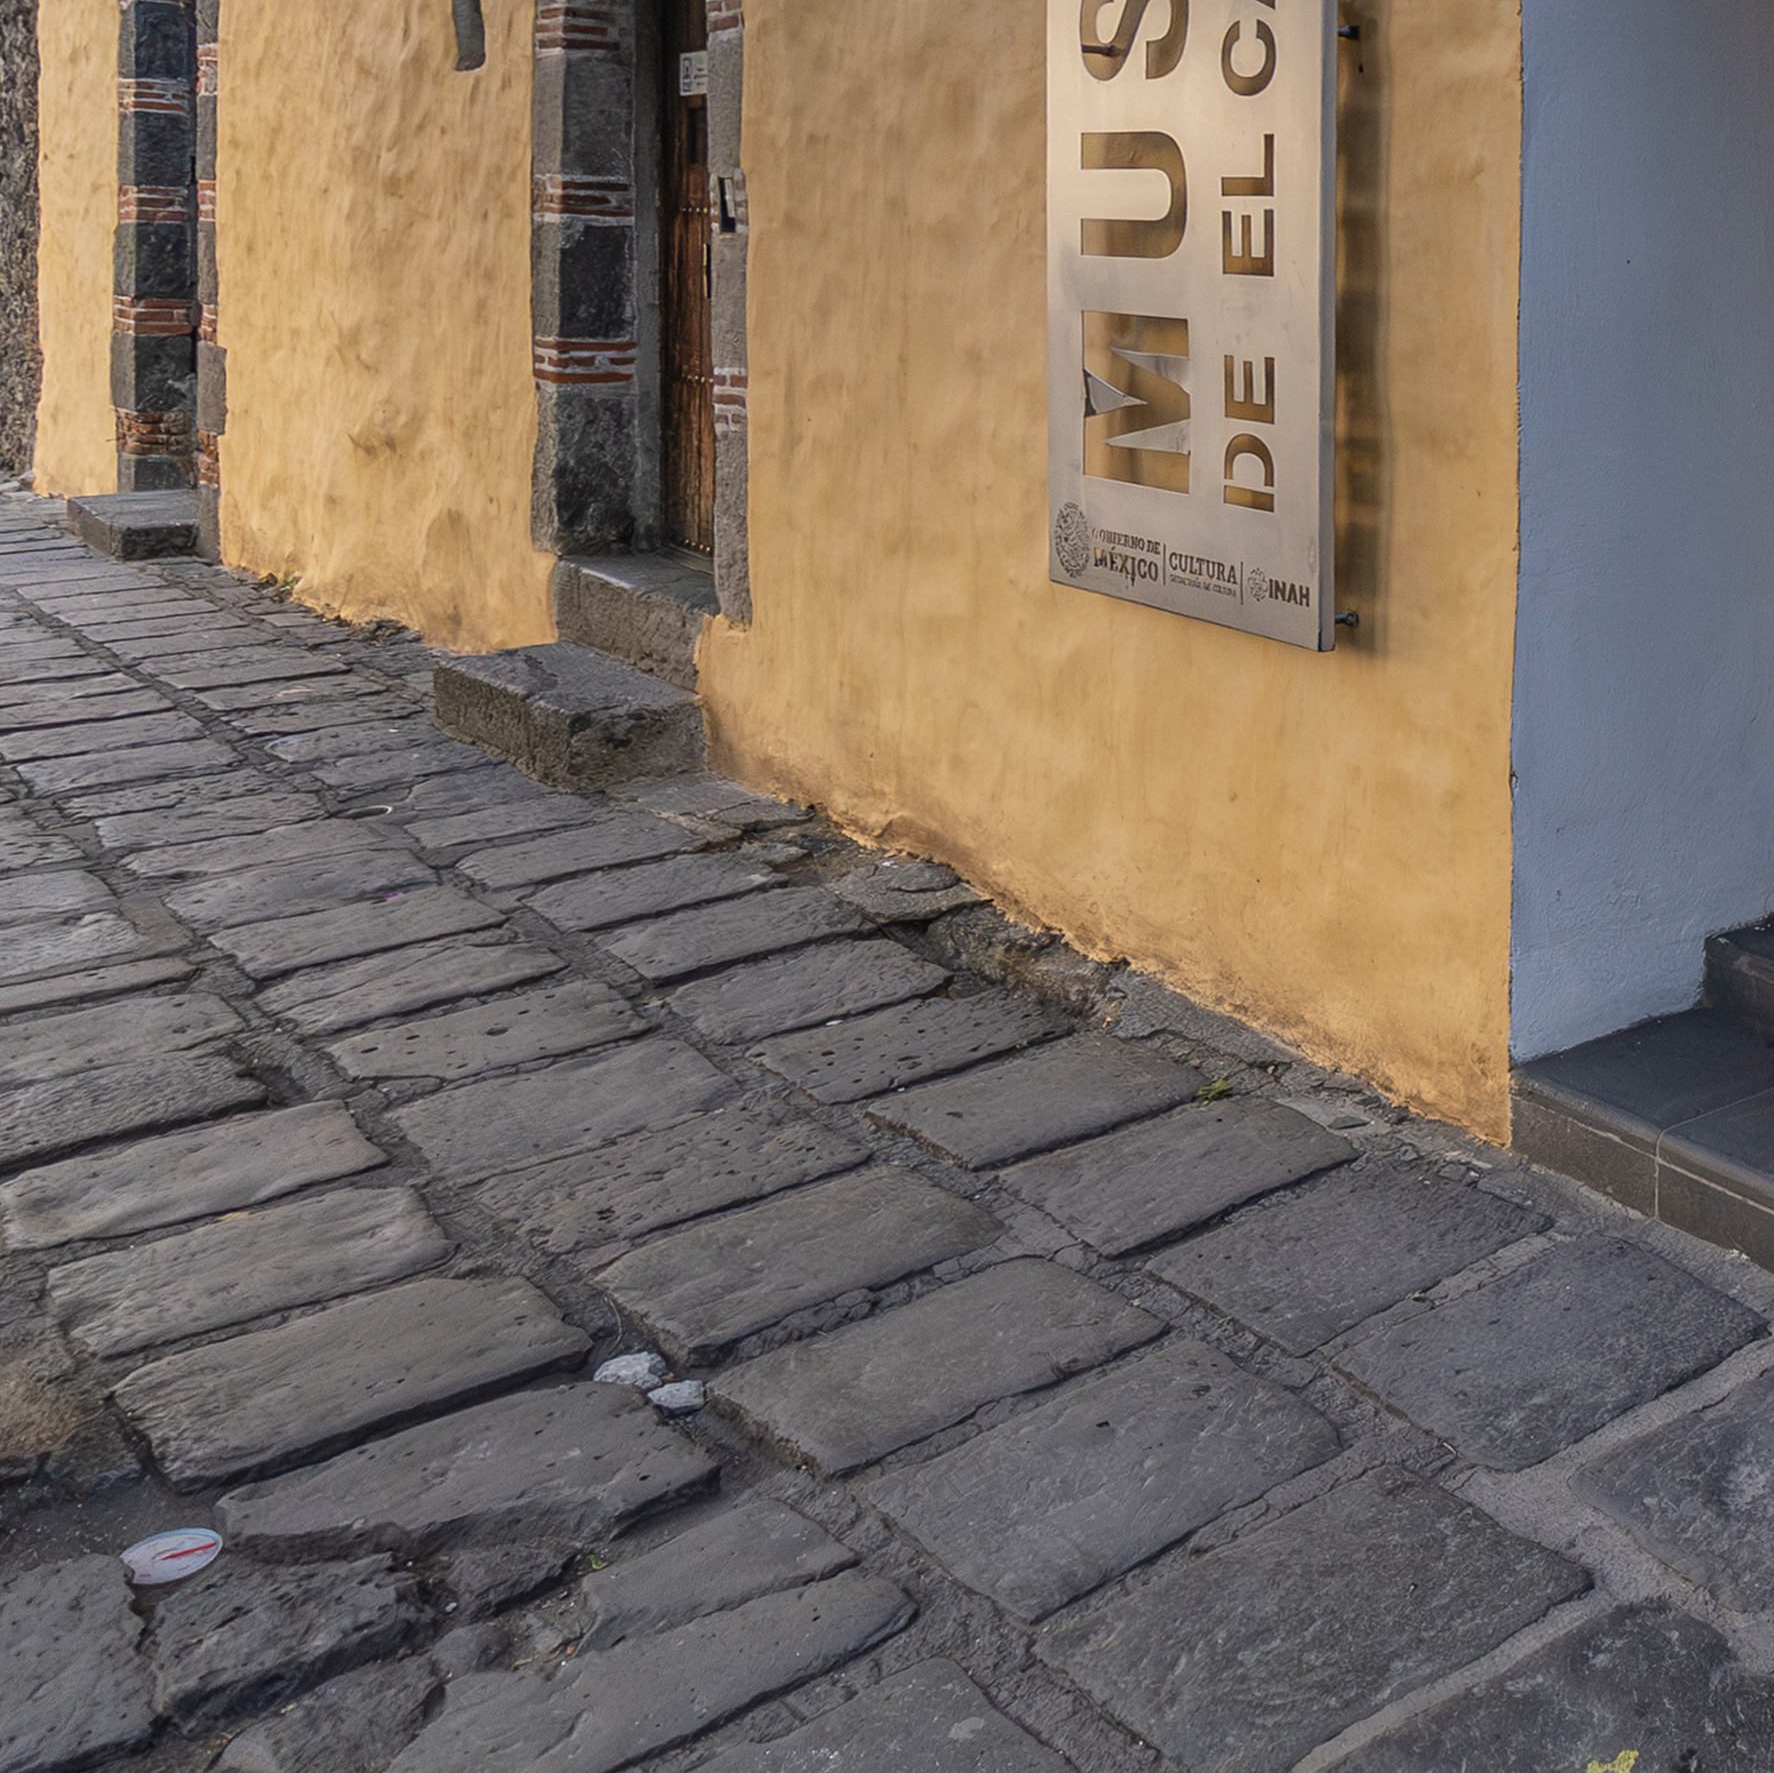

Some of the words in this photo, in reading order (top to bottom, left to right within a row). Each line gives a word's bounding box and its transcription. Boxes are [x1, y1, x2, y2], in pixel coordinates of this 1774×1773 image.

[1220, 133, 1275, 277] EL
[1223, 354, 1275, 514] DE
[1092, 528, 1146, 551] GOBIERNO
[1146, 539, 1161, 555] DE
[1093, 545, 1159, 582] MÉXICO
[1168, 552, 1238, 584] CULTURA
[1268, 578, 1310, 607] INAH
